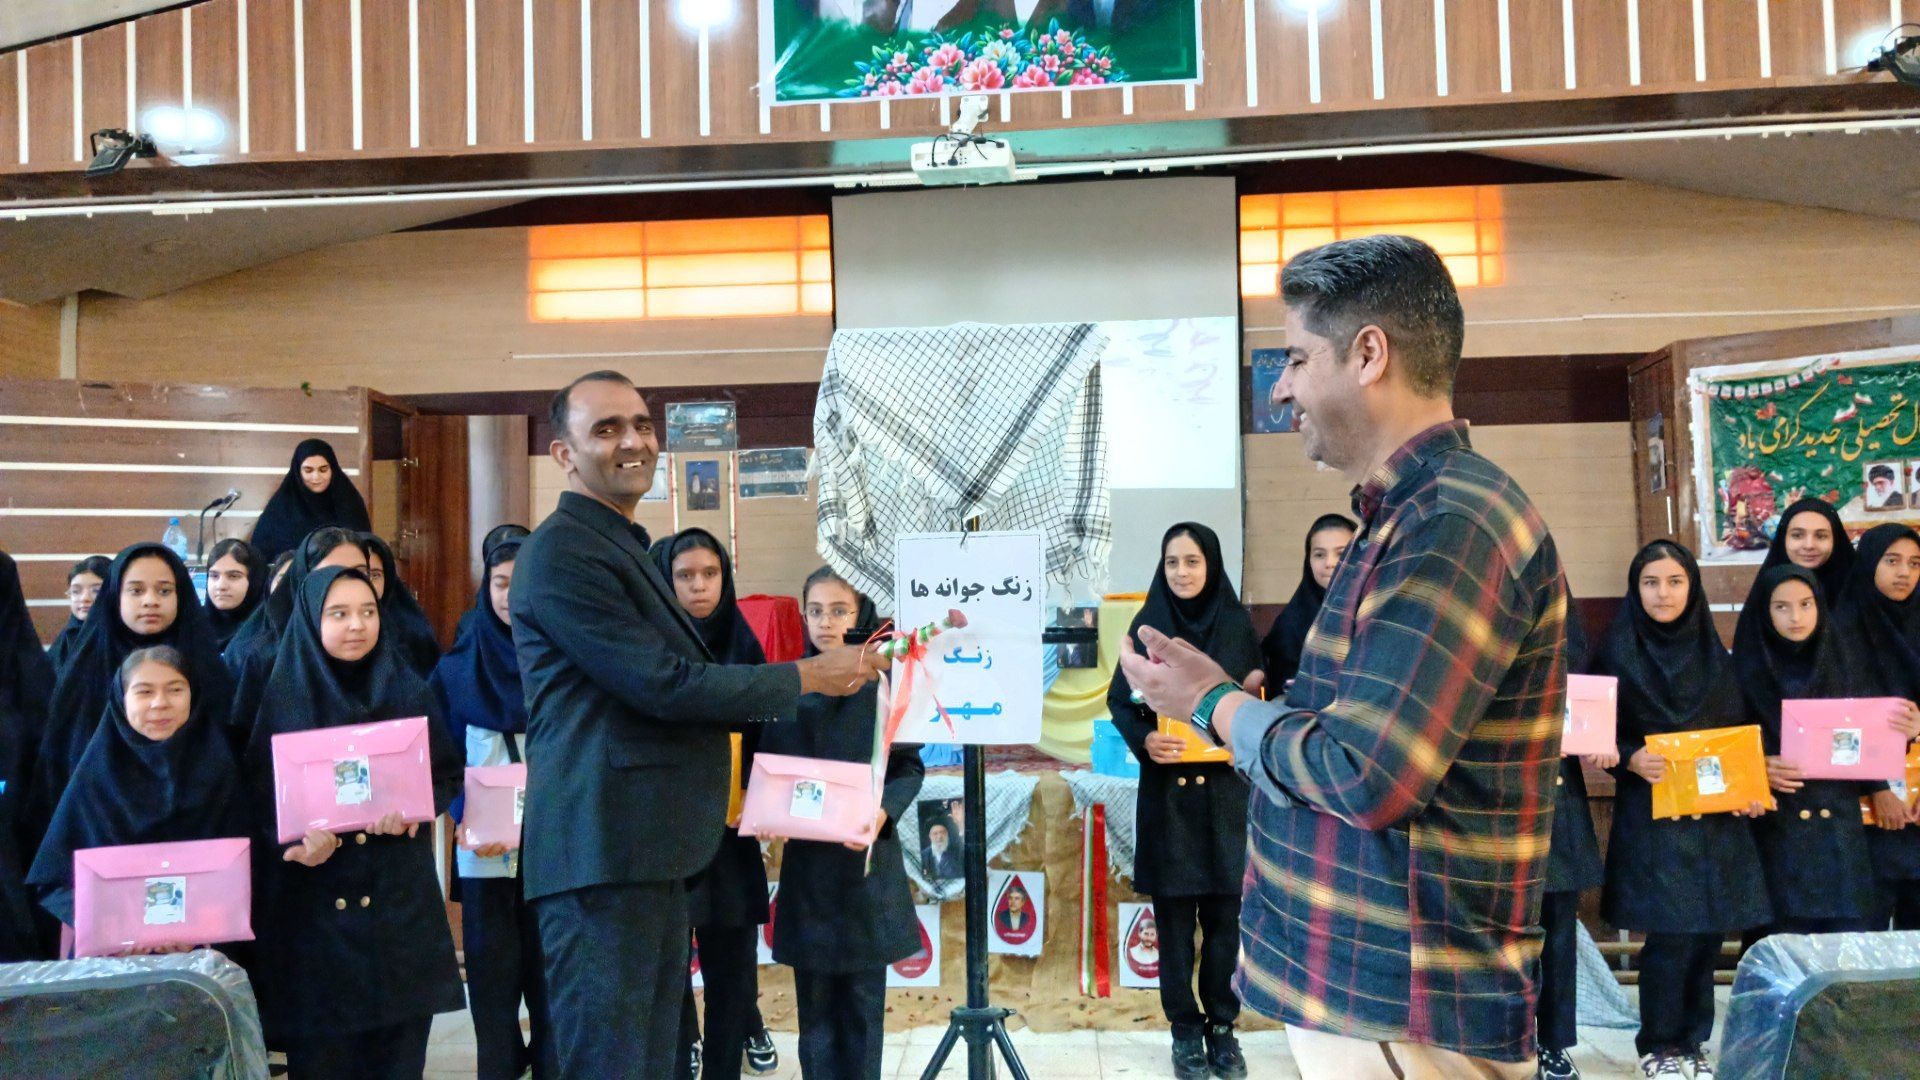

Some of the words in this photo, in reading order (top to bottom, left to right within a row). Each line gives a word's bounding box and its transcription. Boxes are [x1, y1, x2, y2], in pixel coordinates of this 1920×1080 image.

[1759, 380, 1831, 454] گرامی
[1841, 393, 1908, 461] تحصیلی
[1736, 425, 1755, 459] باد
[1798, 427, 1841, 458] جدید
[911, 578, 929, 598] ها
[935, 577, 985, 603] جوانه
[992, 575, 1032, 601] زنگ
[943, 645, 992, 669] زنگ
[929, 701, 1002, 723] مهر
